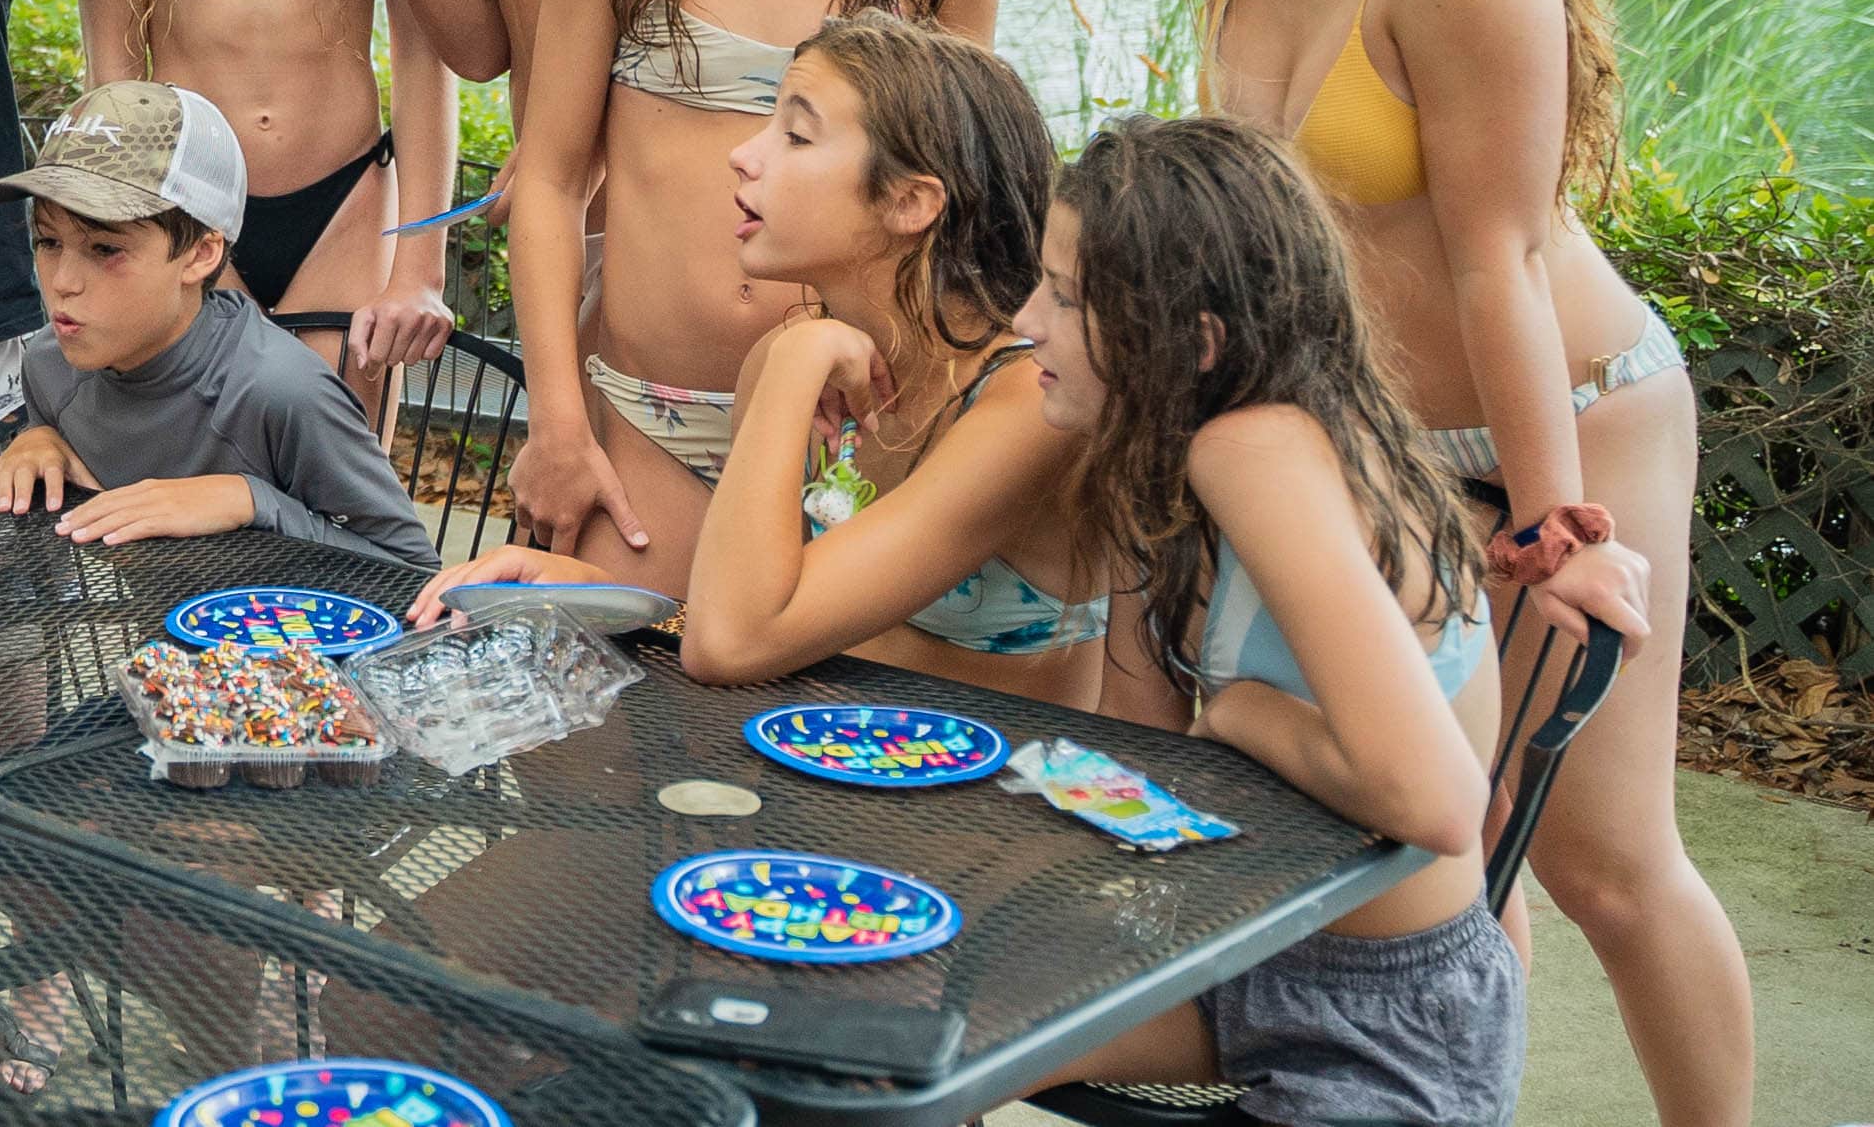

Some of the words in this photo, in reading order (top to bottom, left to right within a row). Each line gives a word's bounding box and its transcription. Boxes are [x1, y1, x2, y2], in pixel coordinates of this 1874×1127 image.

[822, 752, 959, 770] HAPPY
[694, 889, 928, 935] BIRTHDAY
[721, 913, 891, 946] HAPPY
